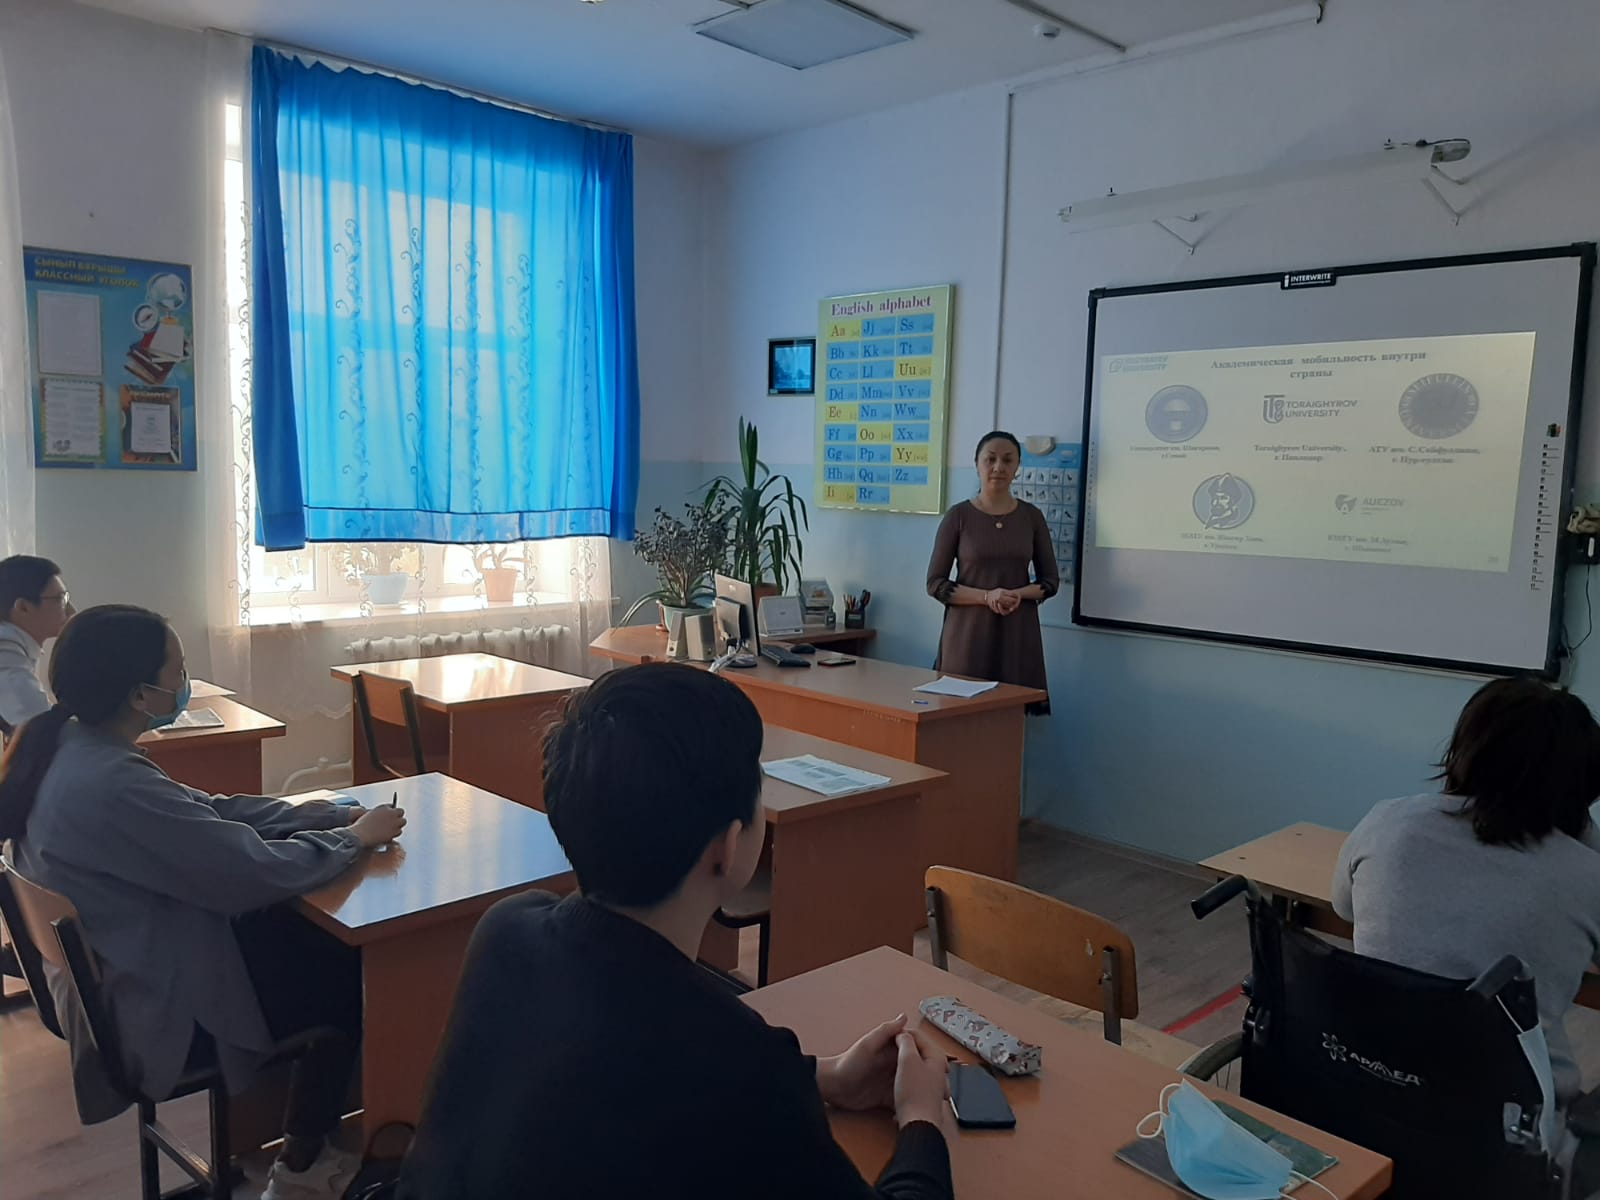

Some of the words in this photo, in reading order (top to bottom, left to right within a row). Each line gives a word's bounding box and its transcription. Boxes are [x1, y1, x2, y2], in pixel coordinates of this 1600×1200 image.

[1290, 273, 1331, 283] INTERWRITE
[831, 300, 874, 316] English
[879, 295, 932, 314] alphabet
[900, 318, 914, 331] Ss
[831, 325, 845, 337] Aa
[831, 348, 844, 360] Bb
[863, 345, 880, 357] Kk
[900, 342, 912, 354] Tt
[1210, 356, 1294, 369] Академическая
[1301, 354, 1377, 366] мобильность
[1381, 352, 1427, 363] внутри
[899, 363, 916, 376] Uu
[1290, 369, 1333, 380] страны
[829, 388, 843, 400] Dd
[862, 386, 882, 399] Mm
[899, 385, 915, 397] Vv
[894, 403, 917, 416] Ww
[1285, 399, 1358, 409] TORAIGHYROV
[829, 406, 841, 418] Ee
[861, 405, 877, 417] Nn
[1285, 409, 1340, 418] UNIVERSITY
[828, 428, 840, 440] Ff
[860, 428, 874, 440] Oo
[896, 428, 913, 440] Xx
[827, 449, 842, 461] Gg
[860, 447, 874, 462] Pp
[896, 447, 912, 463] Yy
[827, 468, 842, 480] Hh
[859, 468, 873, 482] Qq
[895, 469, 909, 481] Zz
[859, 487, 873, 499] Rr
